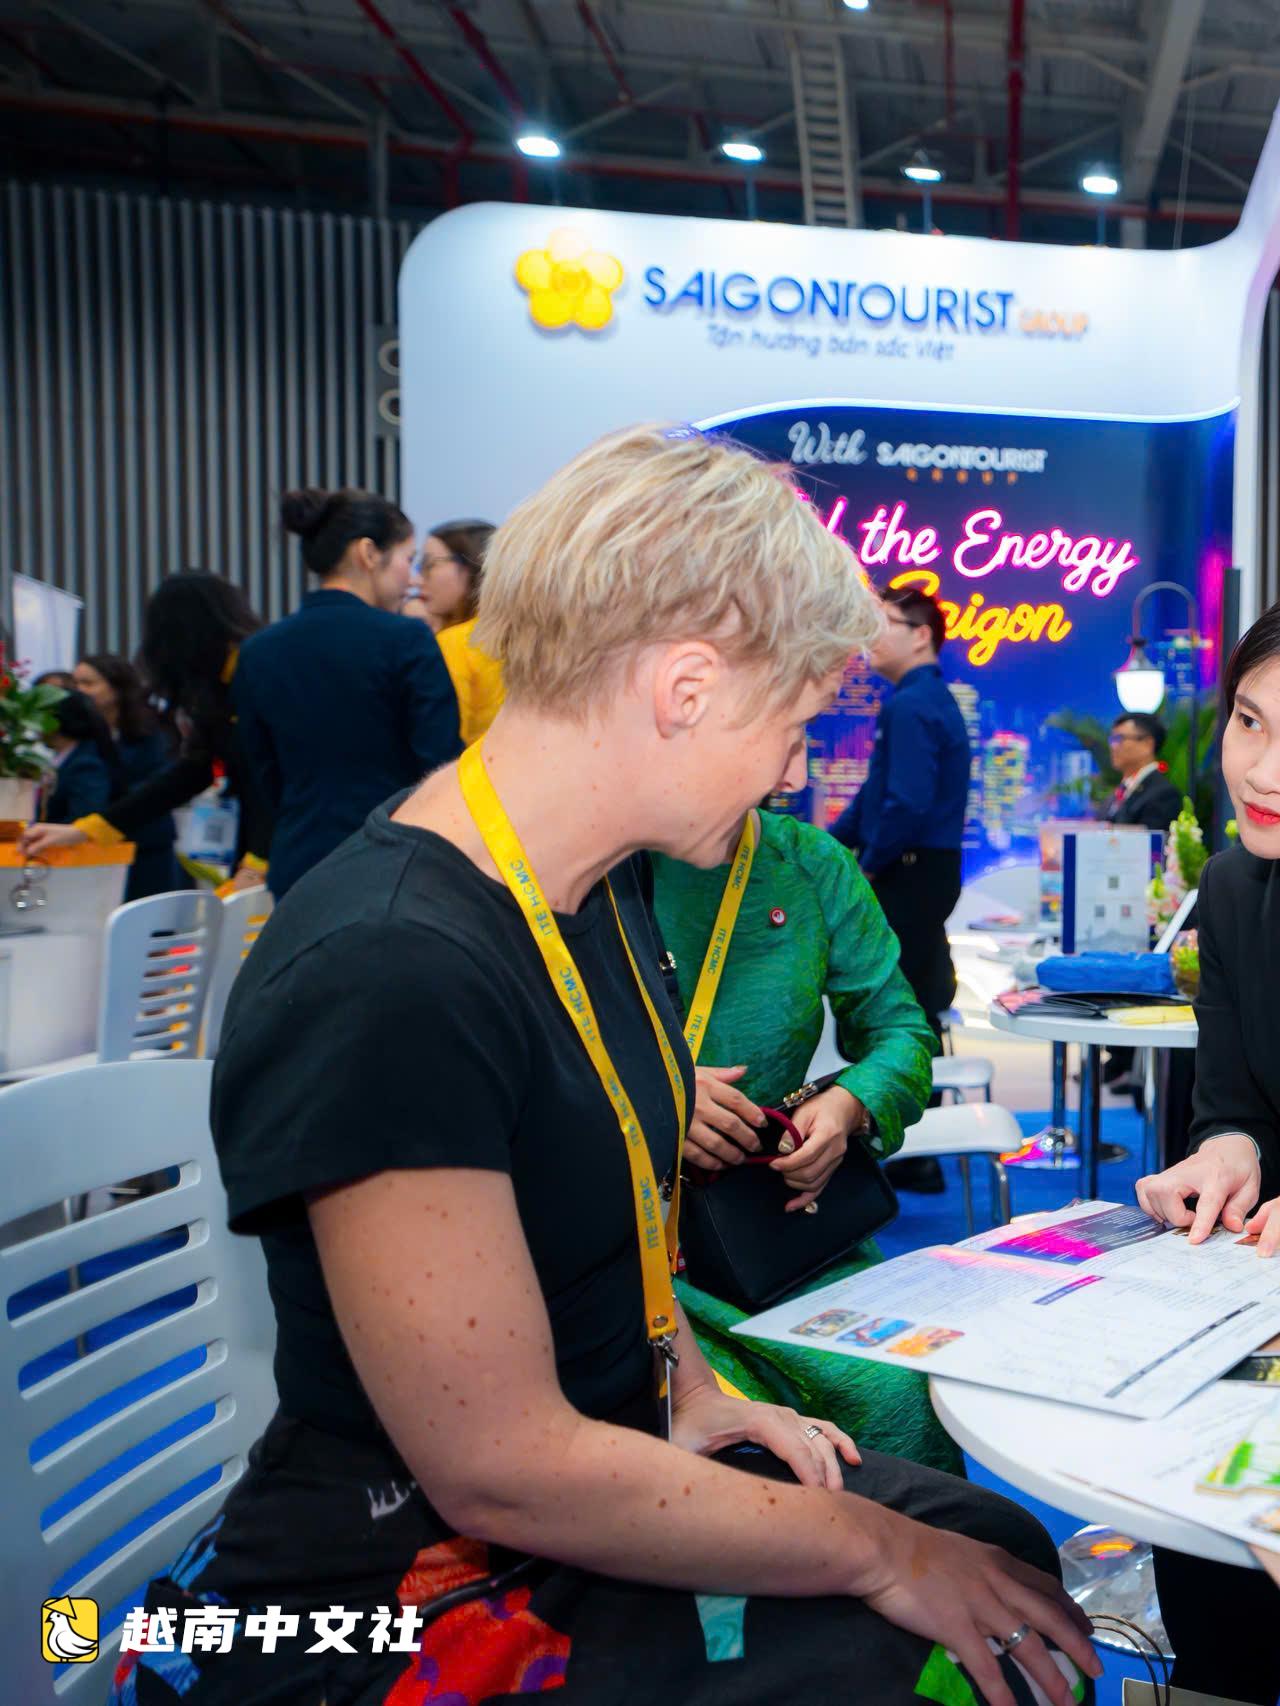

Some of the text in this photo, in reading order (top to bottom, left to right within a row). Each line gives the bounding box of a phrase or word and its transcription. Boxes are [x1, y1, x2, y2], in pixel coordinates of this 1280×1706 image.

[644, 266, 1015, 332] SAIGONTOURIST
[788, 421, 867, 465] With
[859, 501, 942, 564] the
[953, 509, 1139, 596] Energy
[510, 859, 552, 936] ITE HCMC
[559, 966, 587, 1014] HCMC
